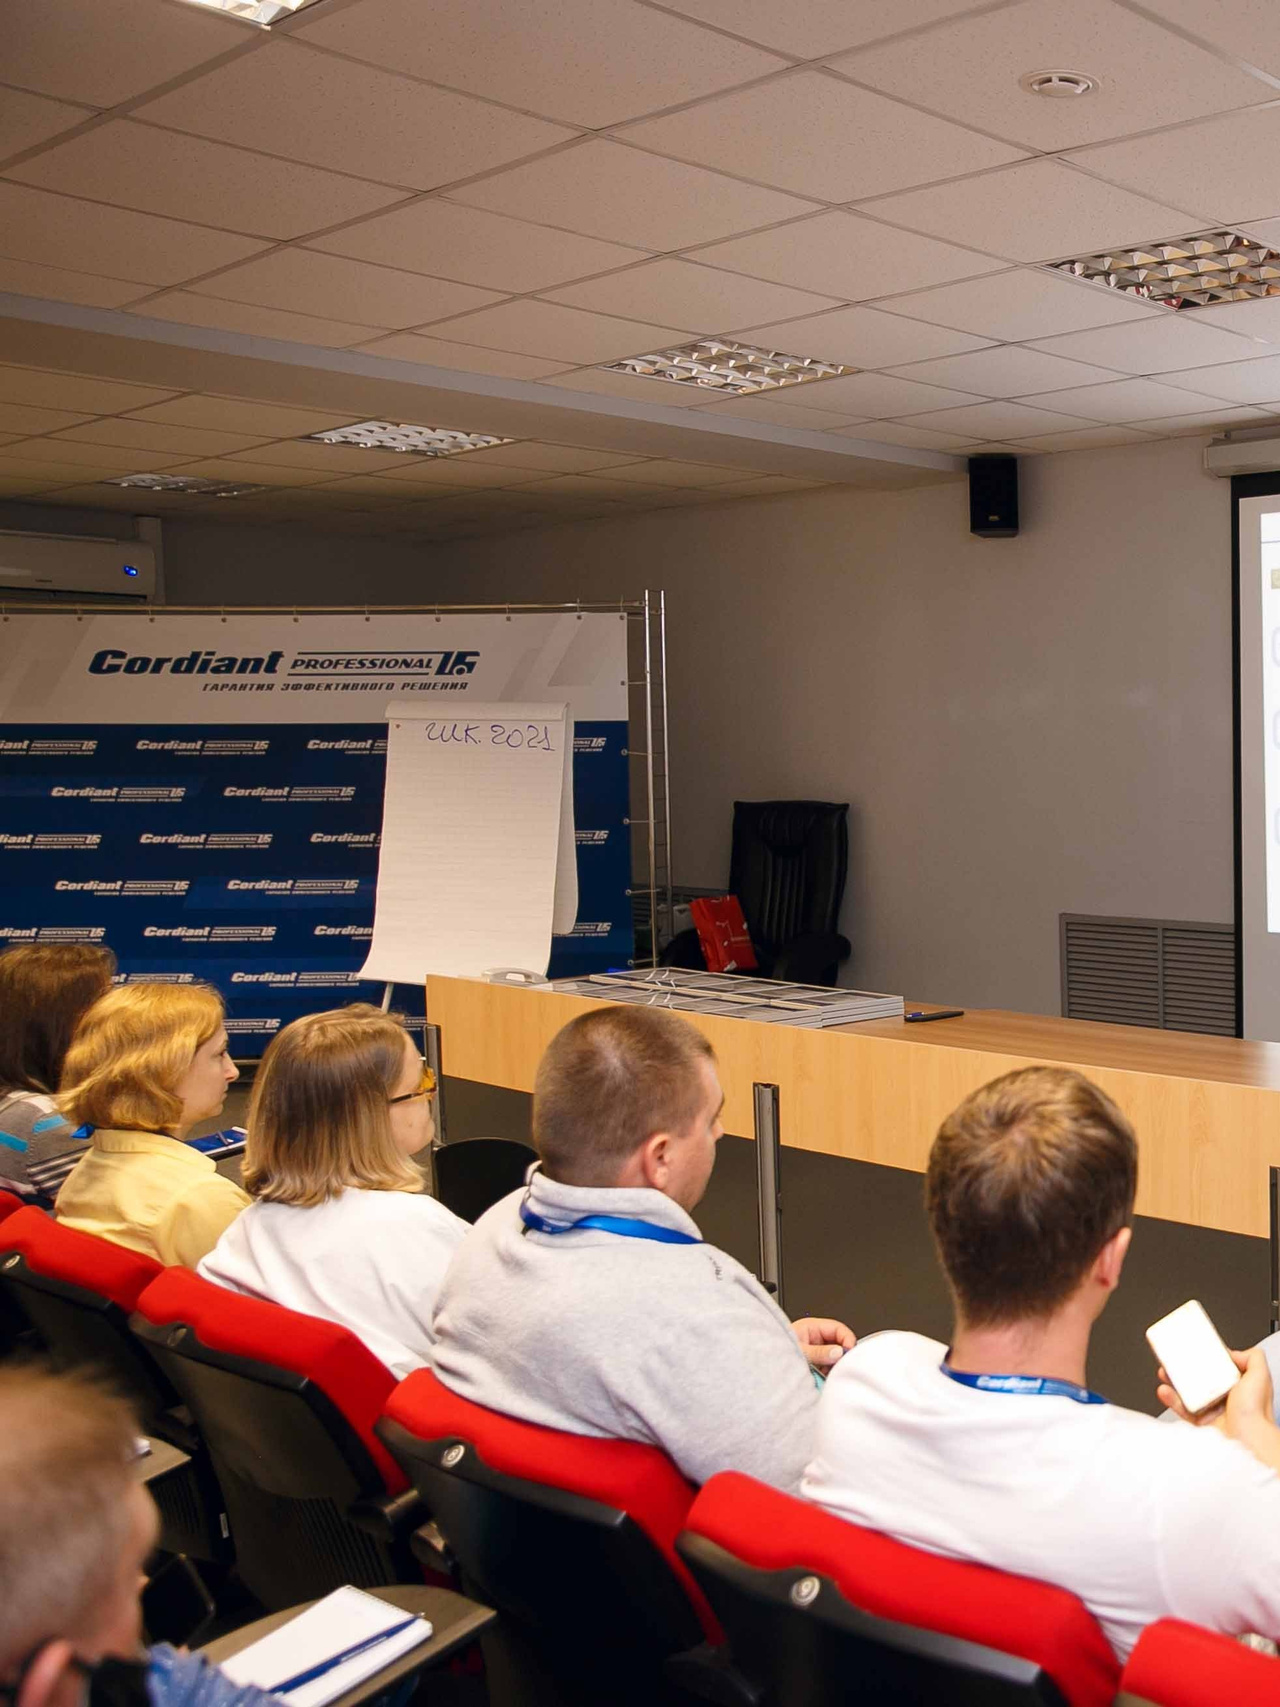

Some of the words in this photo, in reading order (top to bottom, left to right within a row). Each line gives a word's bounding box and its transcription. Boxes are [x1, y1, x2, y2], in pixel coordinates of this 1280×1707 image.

[88, 649, 284, 675] Cordiant
[291, 658, 433, 670] PROFESSIONAL
[203, 683, 275, 692] ГАРАНТИЯ
[281, 682, 394, 691] ЭФФЕКТИВНОГО
[401, 681, 468, 691] РЕШЕНИЯ
[490, 724, 555, 751] 2021
[0, 740, 29, 749] iant
[136, 740, 203, 750] Cordiant
[307, 739, 373, 749] Cordiant
[51, 787, 120, 797] Cordiant
[224, 786, 290, 796] Cordiant
[140, 834, 206, 843] Cordiant
[310, 833, 376, 842] Cordiant
[55, 880, 123, 890] Cordiant
[227, 880, 294, 890] Cordiant
[0, 928, 38, 937] diant
[144, 927, 211, 936] Cordiant
[314, 925, 372, 935] Cordian
[231, 972, 297, 982] Cordiant
